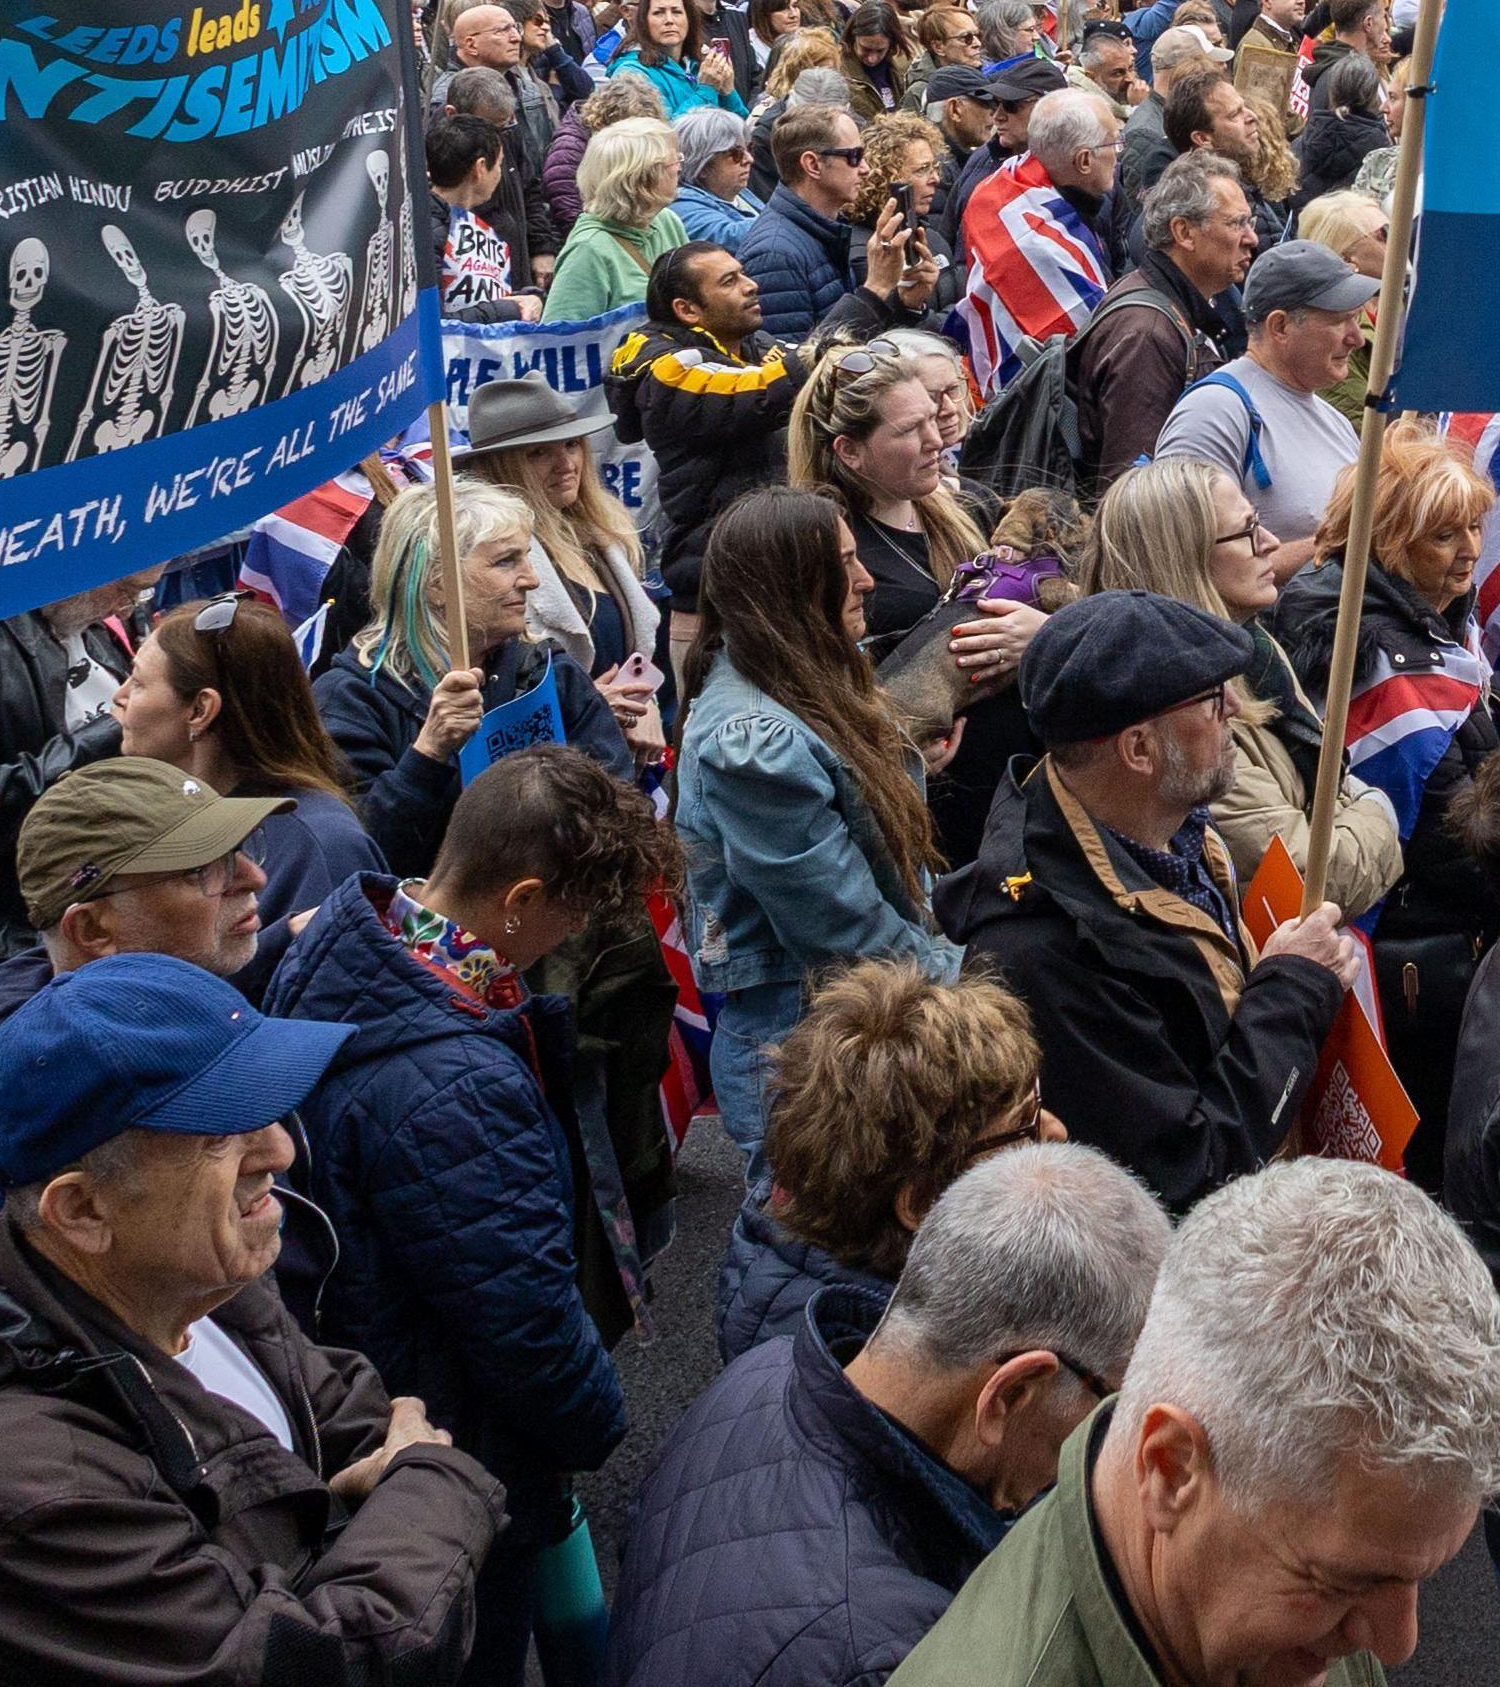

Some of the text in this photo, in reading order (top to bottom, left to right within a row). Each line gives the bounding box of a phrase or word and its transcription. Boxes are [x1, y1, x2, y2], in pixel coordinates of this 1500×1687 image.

[15, 15, 181, 65] LEEDS
[69, 174, 132, 212] HINDU
[153, 166, 290, 203] BUDDHIST
[292, 143, 336, 179] MUSLI
[455, 223, 507, 269] BRITS
[460, 256, 502, 279] AGAINST
[514, 343, 601, 394] WILL
[145, 447, 262, 524] WE'RE
[266, 422, 315, 474] ALL
[330, 394, 366, 443] THE
[376, 350, 416, 412] SAME
